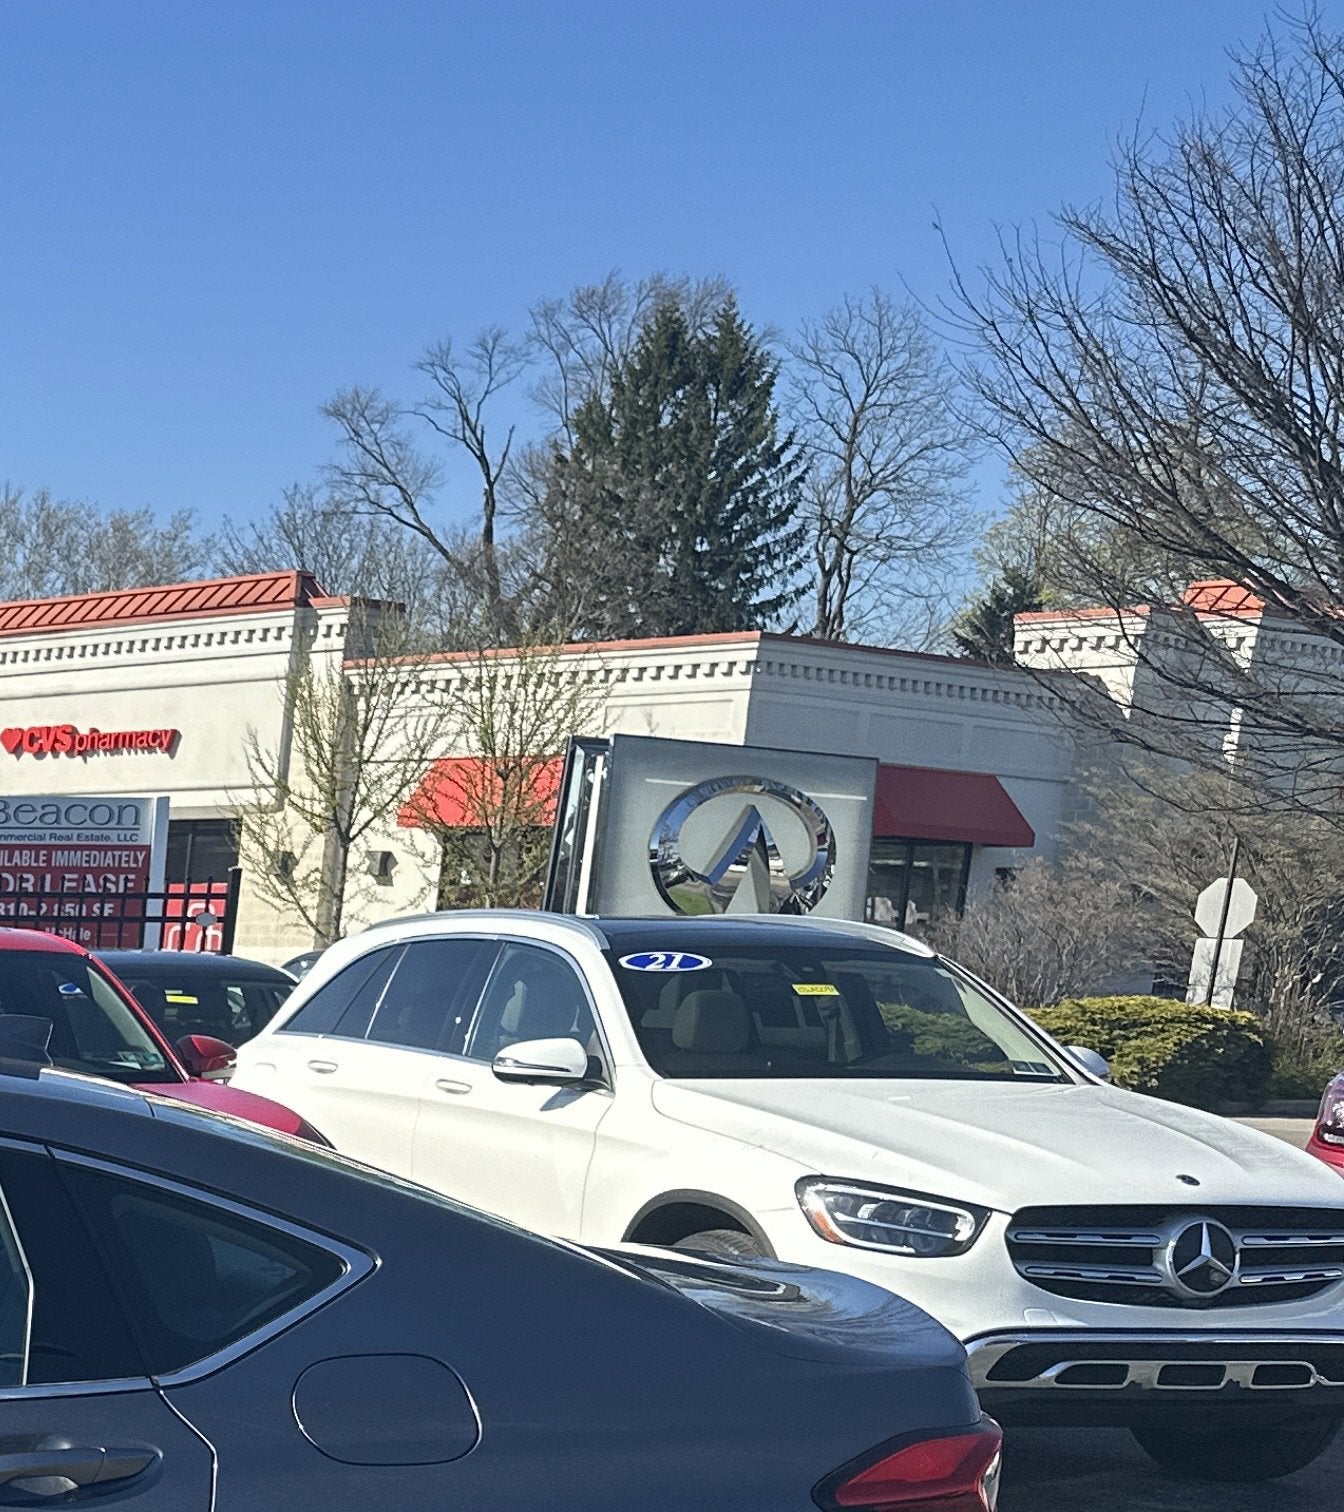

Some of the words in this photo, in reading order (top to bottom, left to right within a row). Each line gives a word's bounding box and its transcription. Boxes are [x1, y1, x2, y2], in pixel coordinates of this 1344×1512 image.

[22, 725, 73, 753] CVS
[74, 728, 174, 756] pharmacy
[49, 832, 74, 843] Real
[117, 833, 139, 843] LLC
[51, 850, 147, 869] IMMEDIATELY
[40, 873, 136, 895] LEASE
[644, 953, 684, 970] 21
